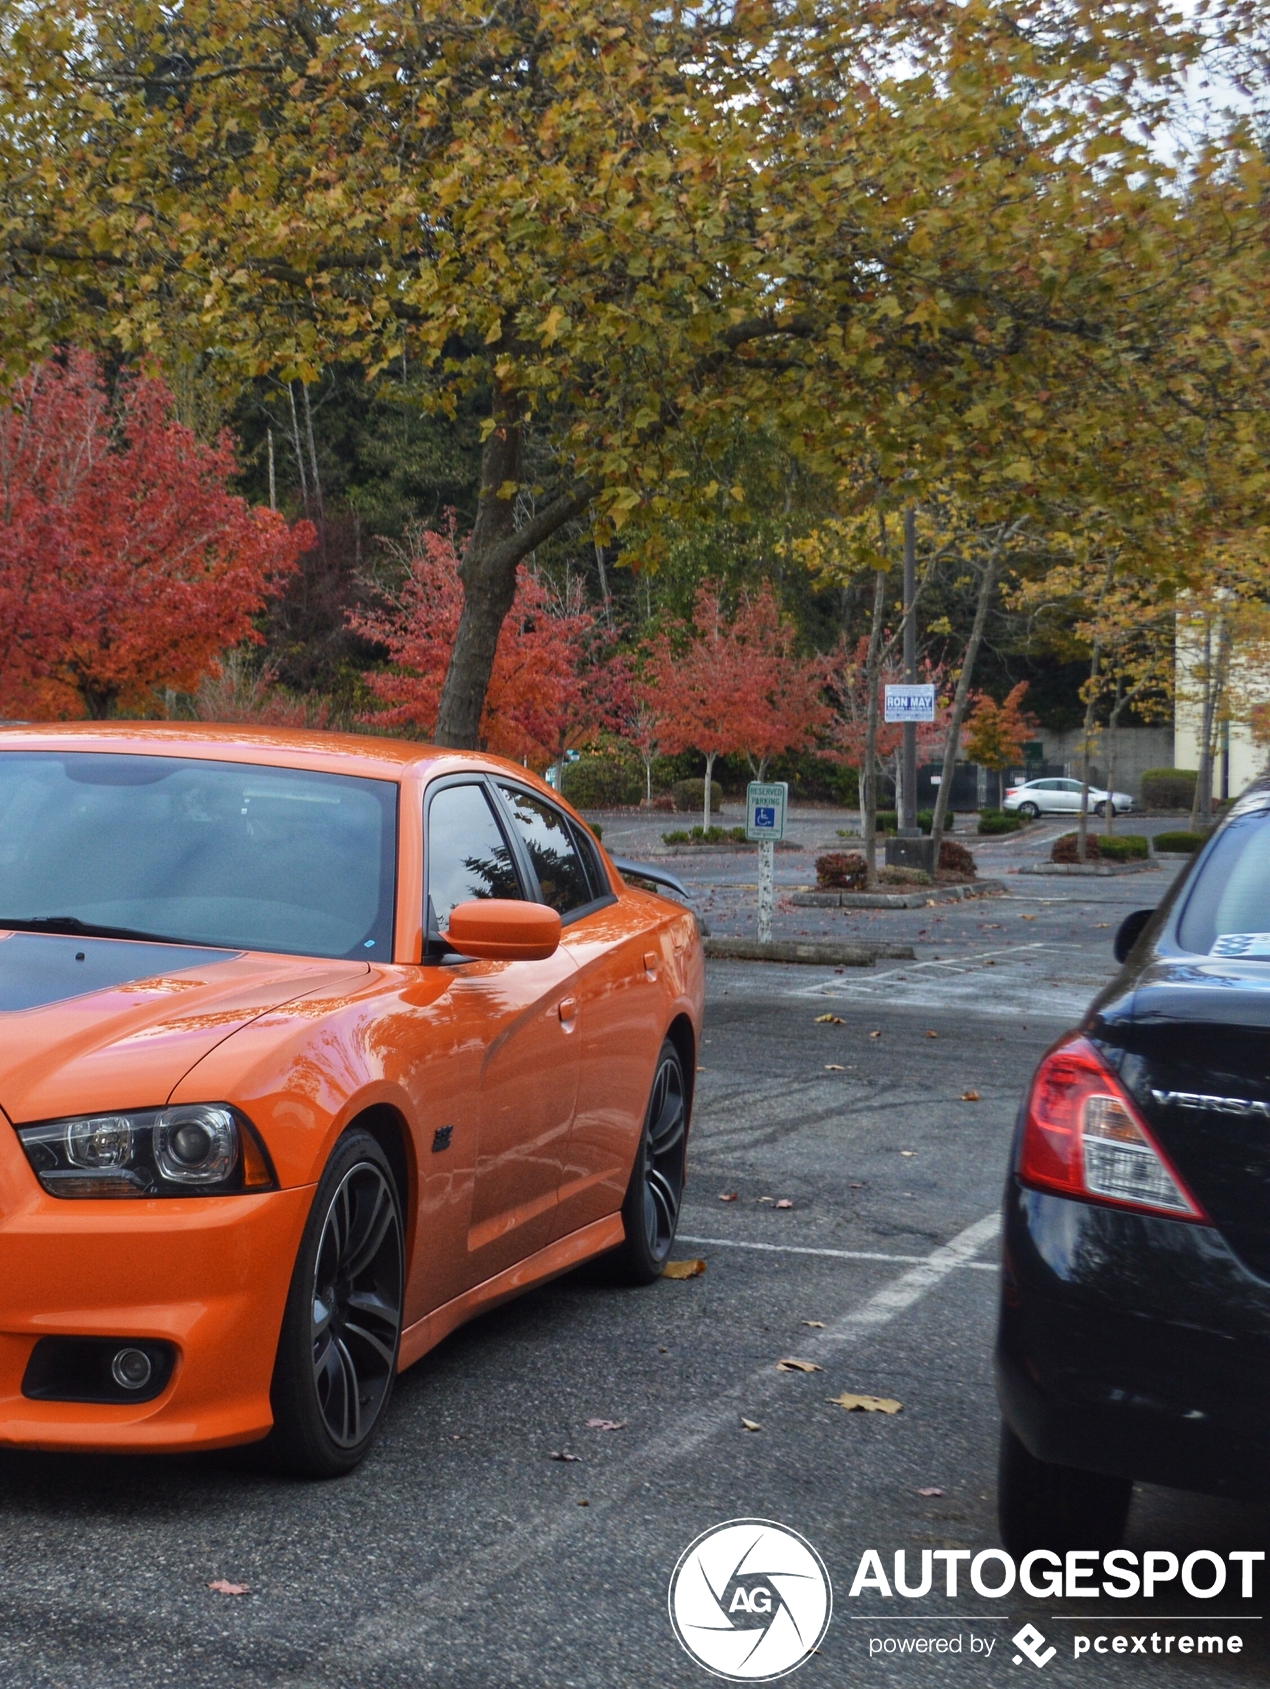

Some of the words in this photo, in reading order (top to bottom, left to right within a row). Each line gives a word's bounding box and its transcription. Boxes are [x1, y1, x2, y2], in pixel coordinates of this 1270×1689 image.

[887, 696, 908, 707] RON
[910, 696, 931, 707] MAY
[750, 787, 783, 796] RESERVED
[751, 797, 780, 806] PARKING
[1151, 1089, 1270, 1117] VERSA
